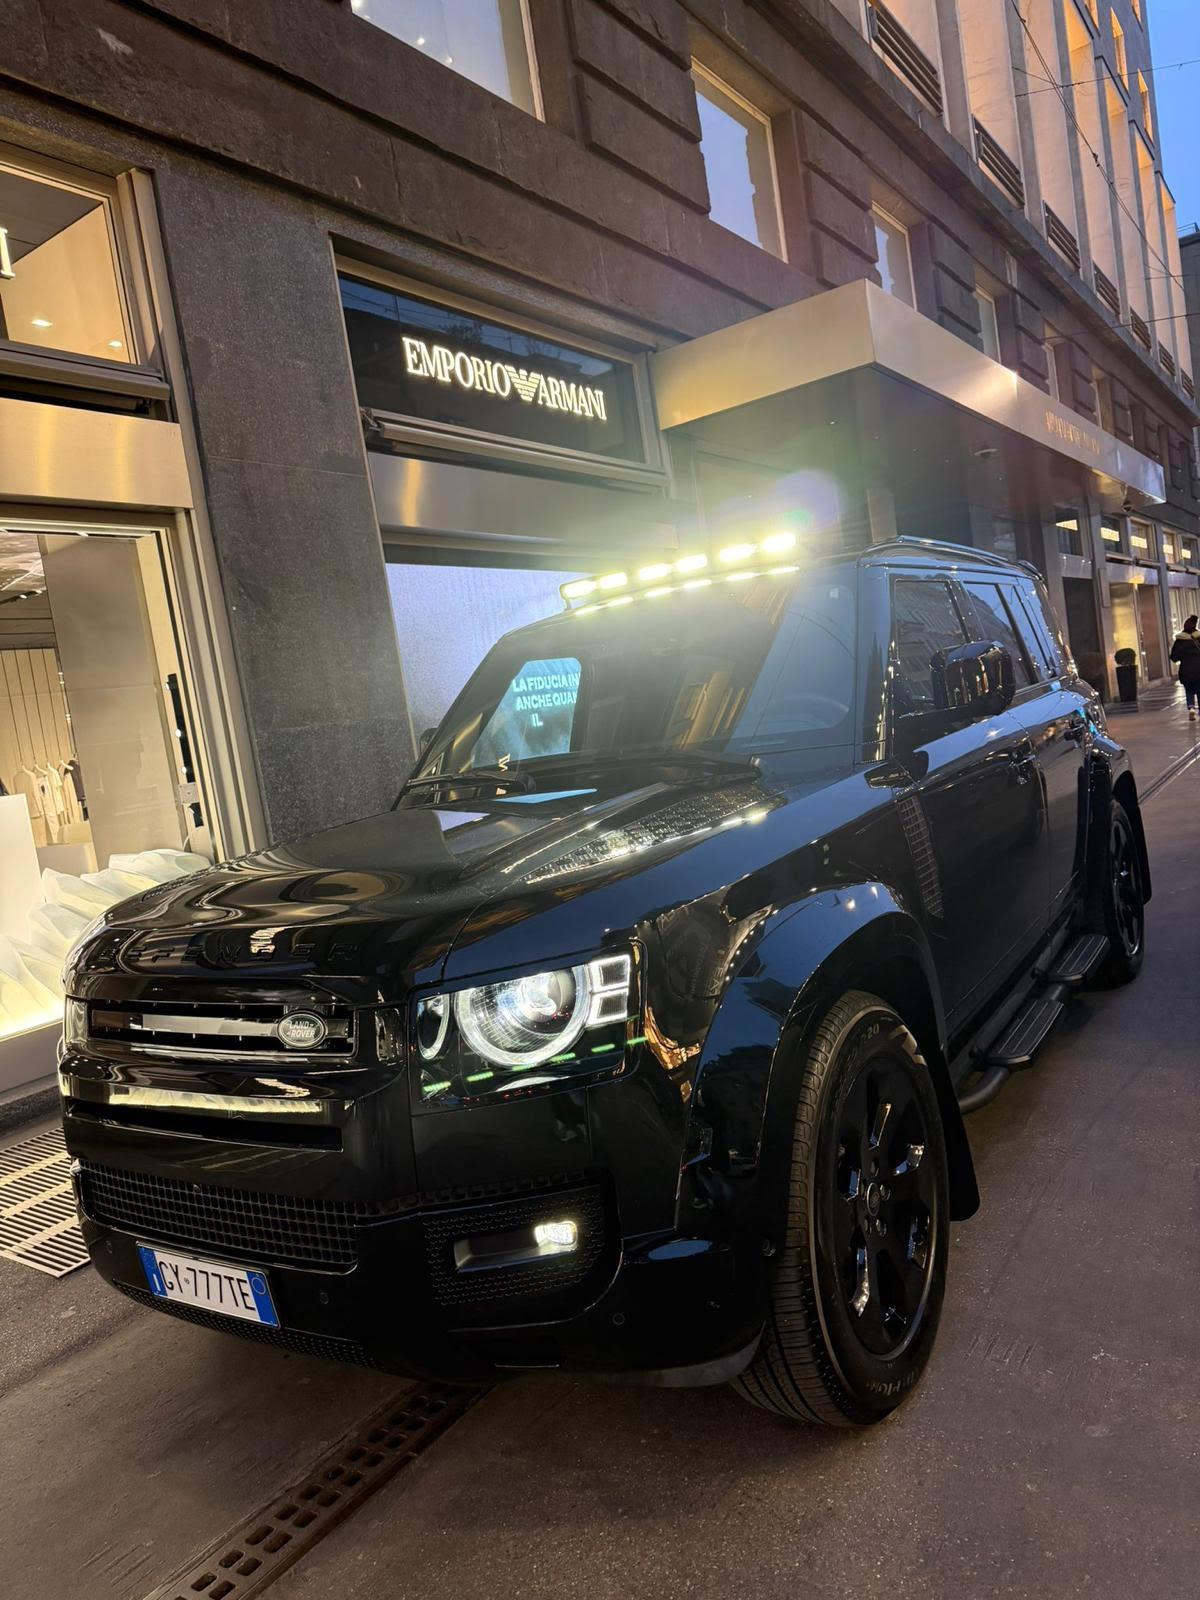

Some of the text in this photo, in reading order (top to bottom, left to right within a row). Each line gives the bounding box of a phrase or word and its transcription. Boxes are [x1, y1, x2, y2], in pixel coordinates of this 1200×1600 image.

[402, 337, 607, 421] EMPORIO ARMANI
[512, 677, 527, 692] LA
[527, 674, 568, 691] FIDUCIA
[516, 694, 553, 711] ANCHE
[532, 713, 544, 727] IL
[289, 1020, 310, 1029] LAND
[290, 1030, 316, 1039] ROVER
